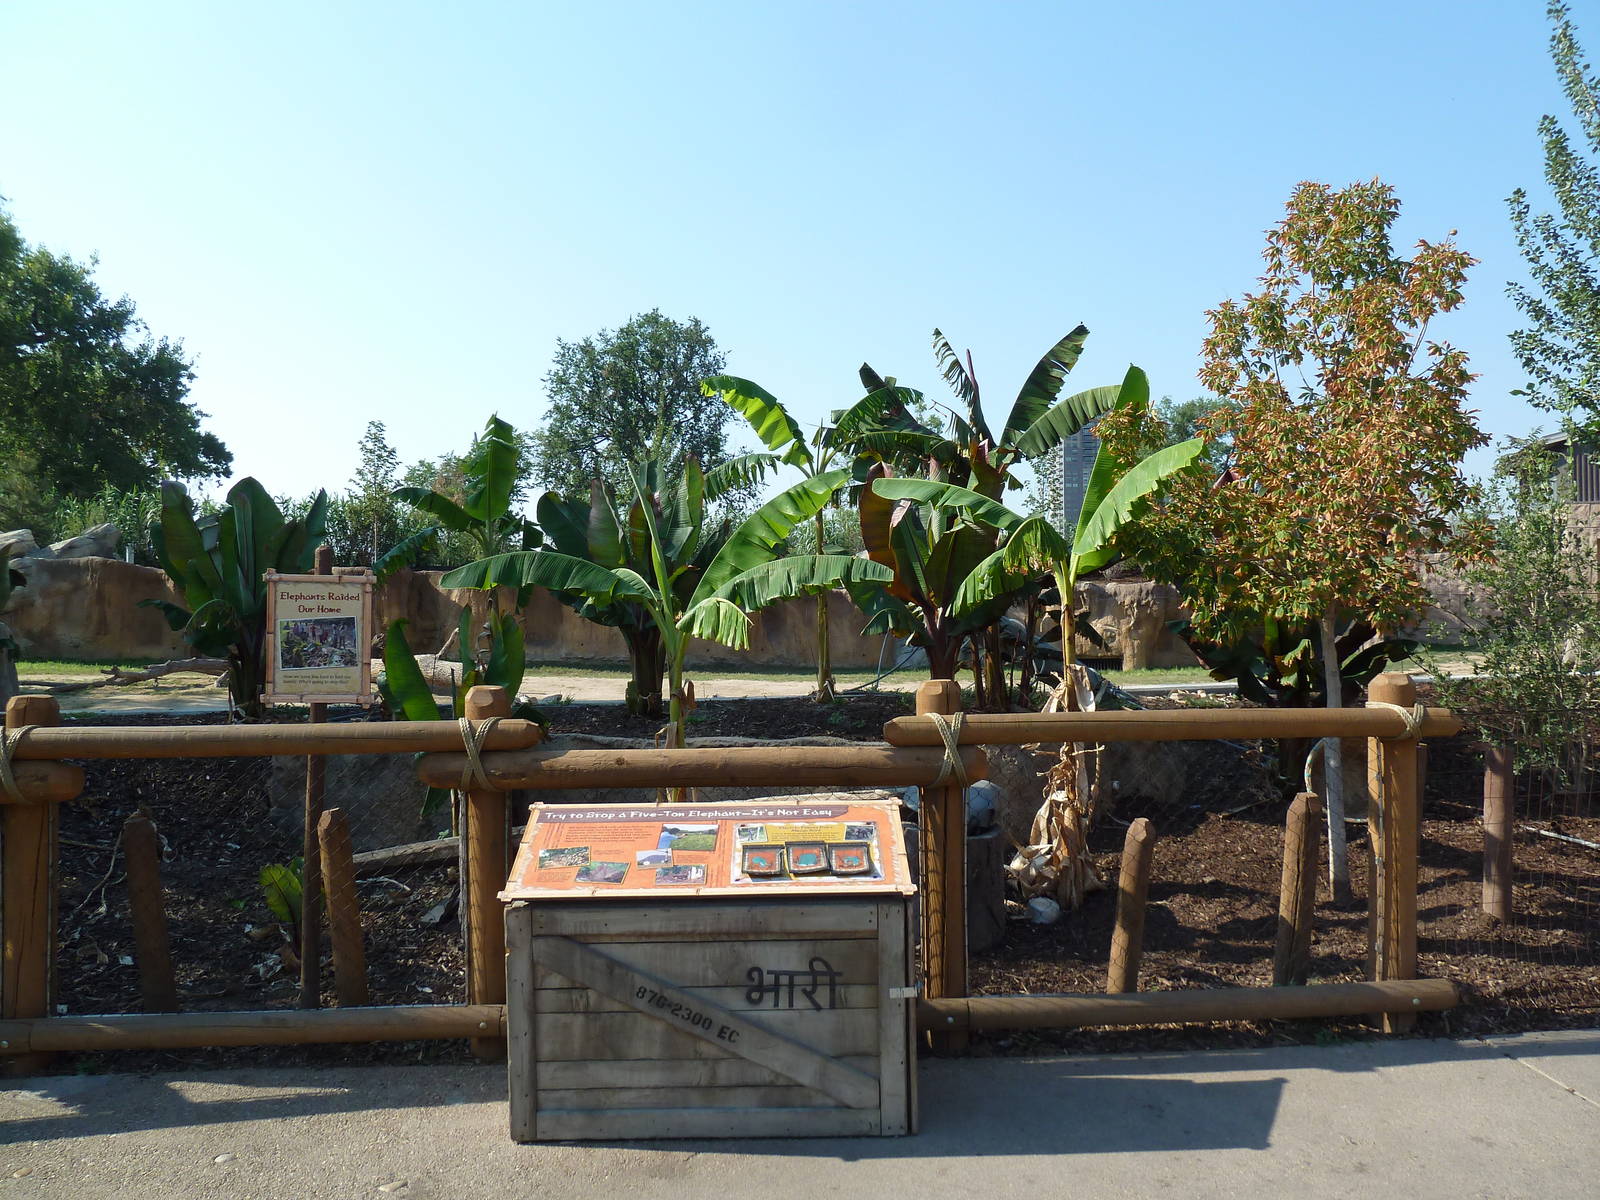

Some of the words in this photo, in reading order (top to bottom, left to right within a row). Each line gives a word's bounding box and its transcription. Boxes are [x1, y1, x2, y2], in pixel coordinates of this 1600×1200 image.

[280, 592, 326, 602] Elephants
[328, 592, 360, 601] Raided
[298, 604, 315, 613] Our
[317, 605, 341, 613] Home
[545, 812, 566, 820] Try
[586, 811, 616, 820] Stop
[630, 810, 685, 819] Five-Ton
[803, 808, 832, 817] Easy
[745, 957, 843, 1012] भारी
[716, 1024, 740, 1044] EC
